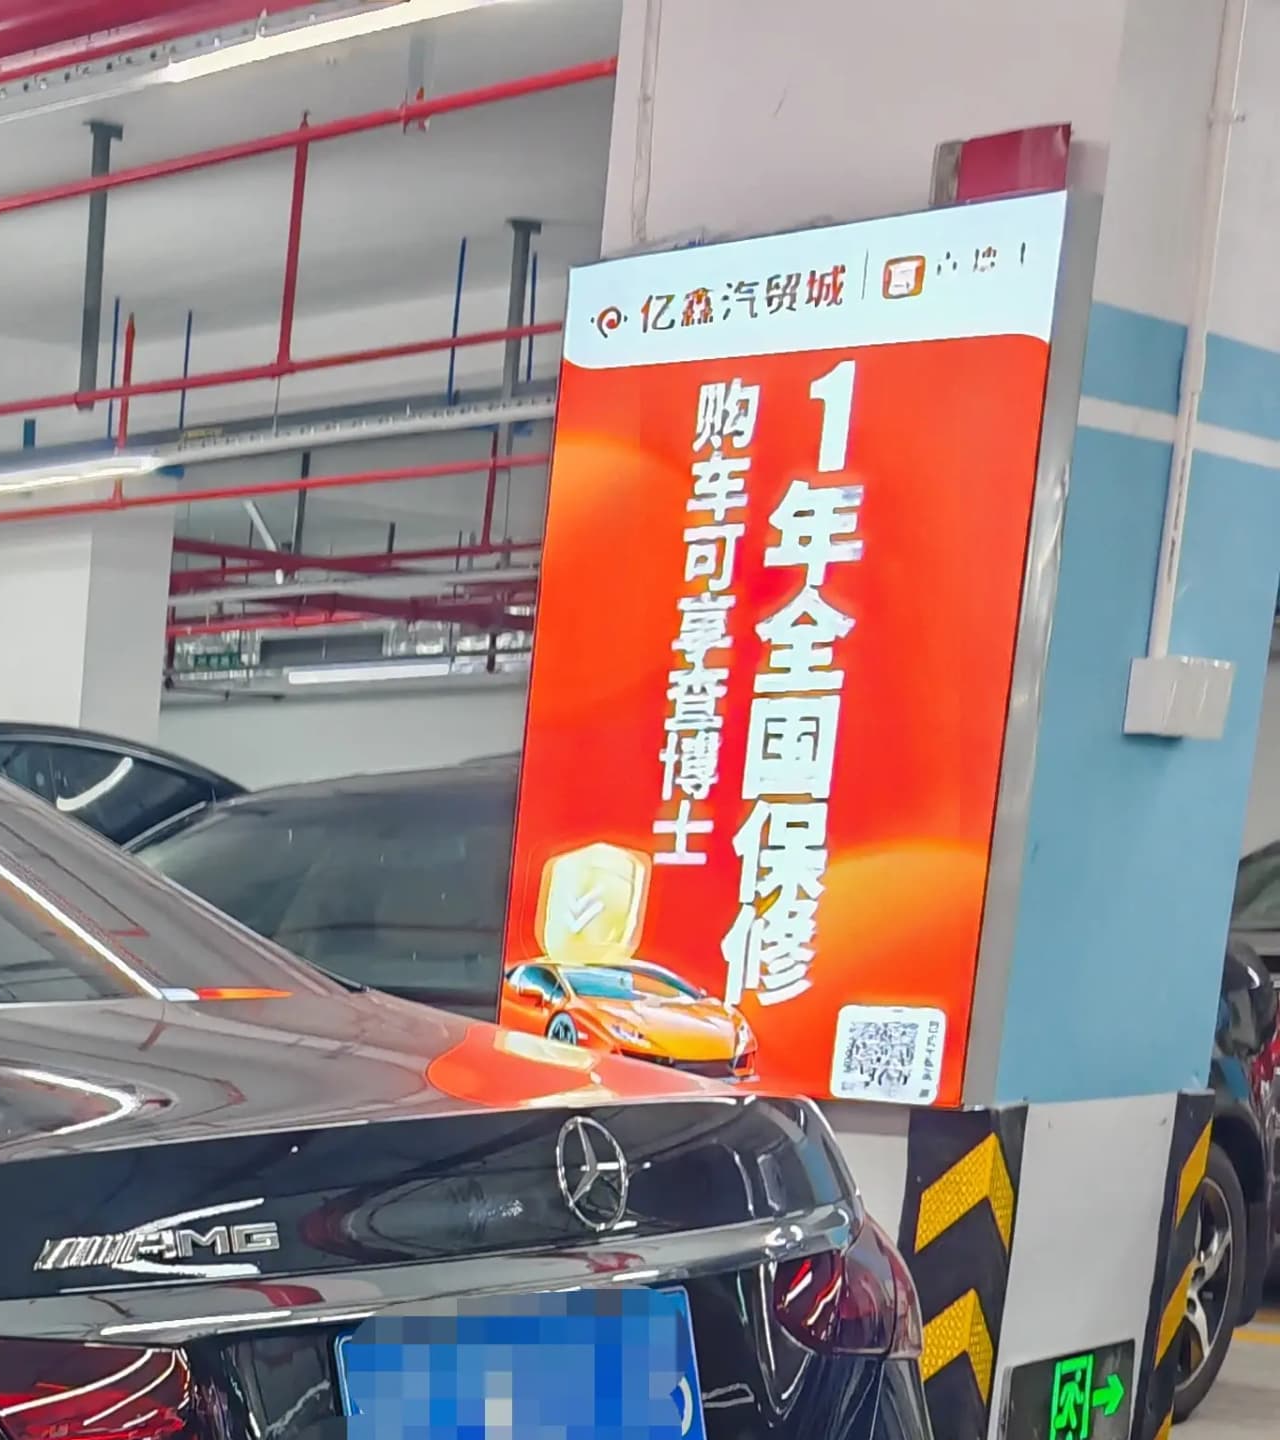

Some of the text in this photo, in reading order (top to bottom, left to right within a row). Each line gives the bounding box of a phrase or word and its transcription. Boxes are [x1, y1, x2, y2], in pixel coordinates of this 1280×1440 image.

[651, 377, 760, 865] 购车可享查博士
[721, 360, 864, 1010] 1年全国保修
